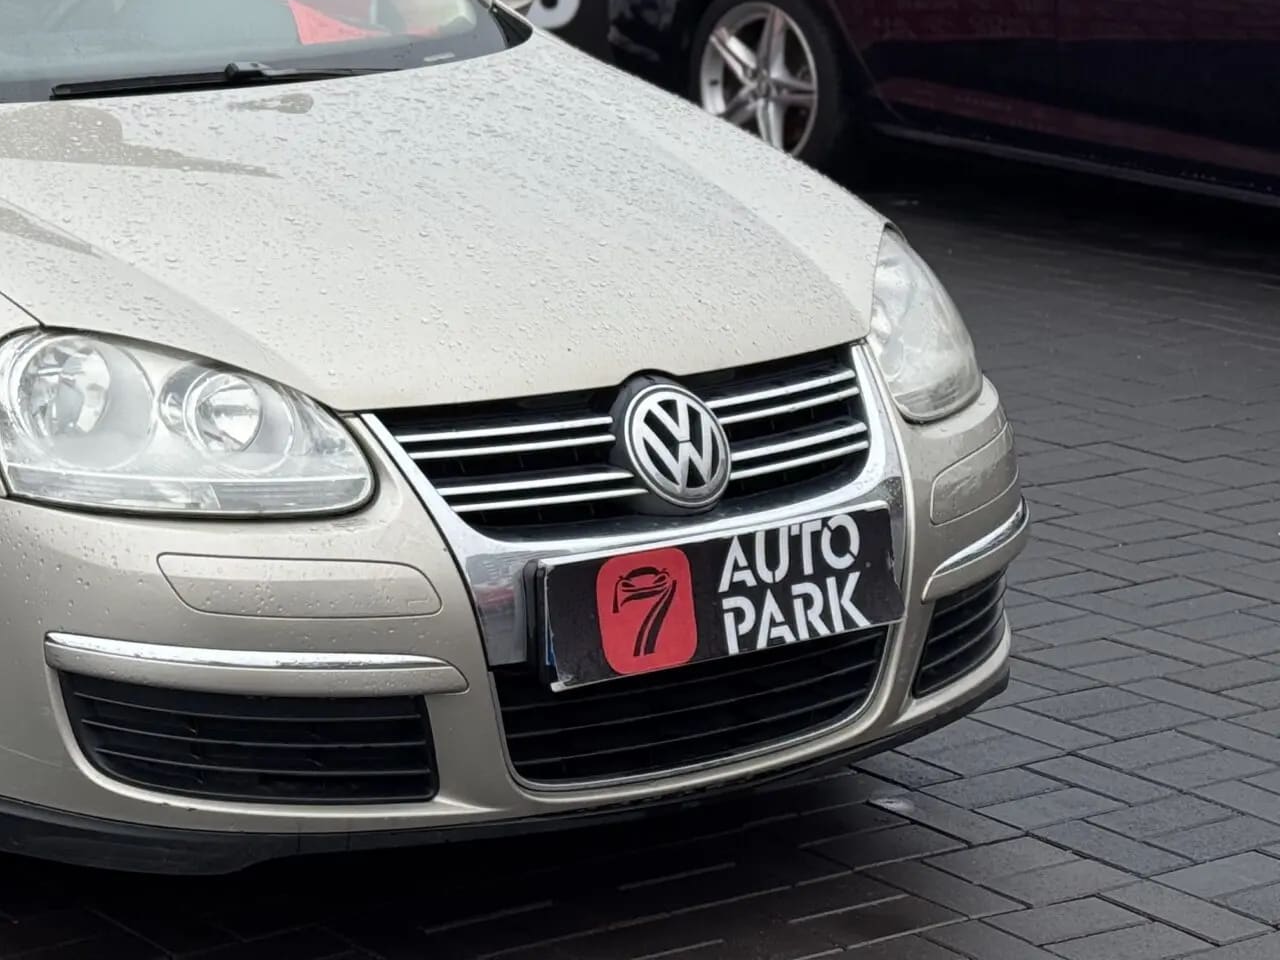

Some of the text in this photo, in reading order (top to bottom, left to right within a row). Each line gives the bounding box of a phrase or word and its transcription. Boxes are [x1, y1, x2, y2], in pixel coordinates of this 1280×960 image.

[631, 390, 726, 503] VW
[718, 514, 860, 593] AUTO
[721, 571, 871, 656] PARK
